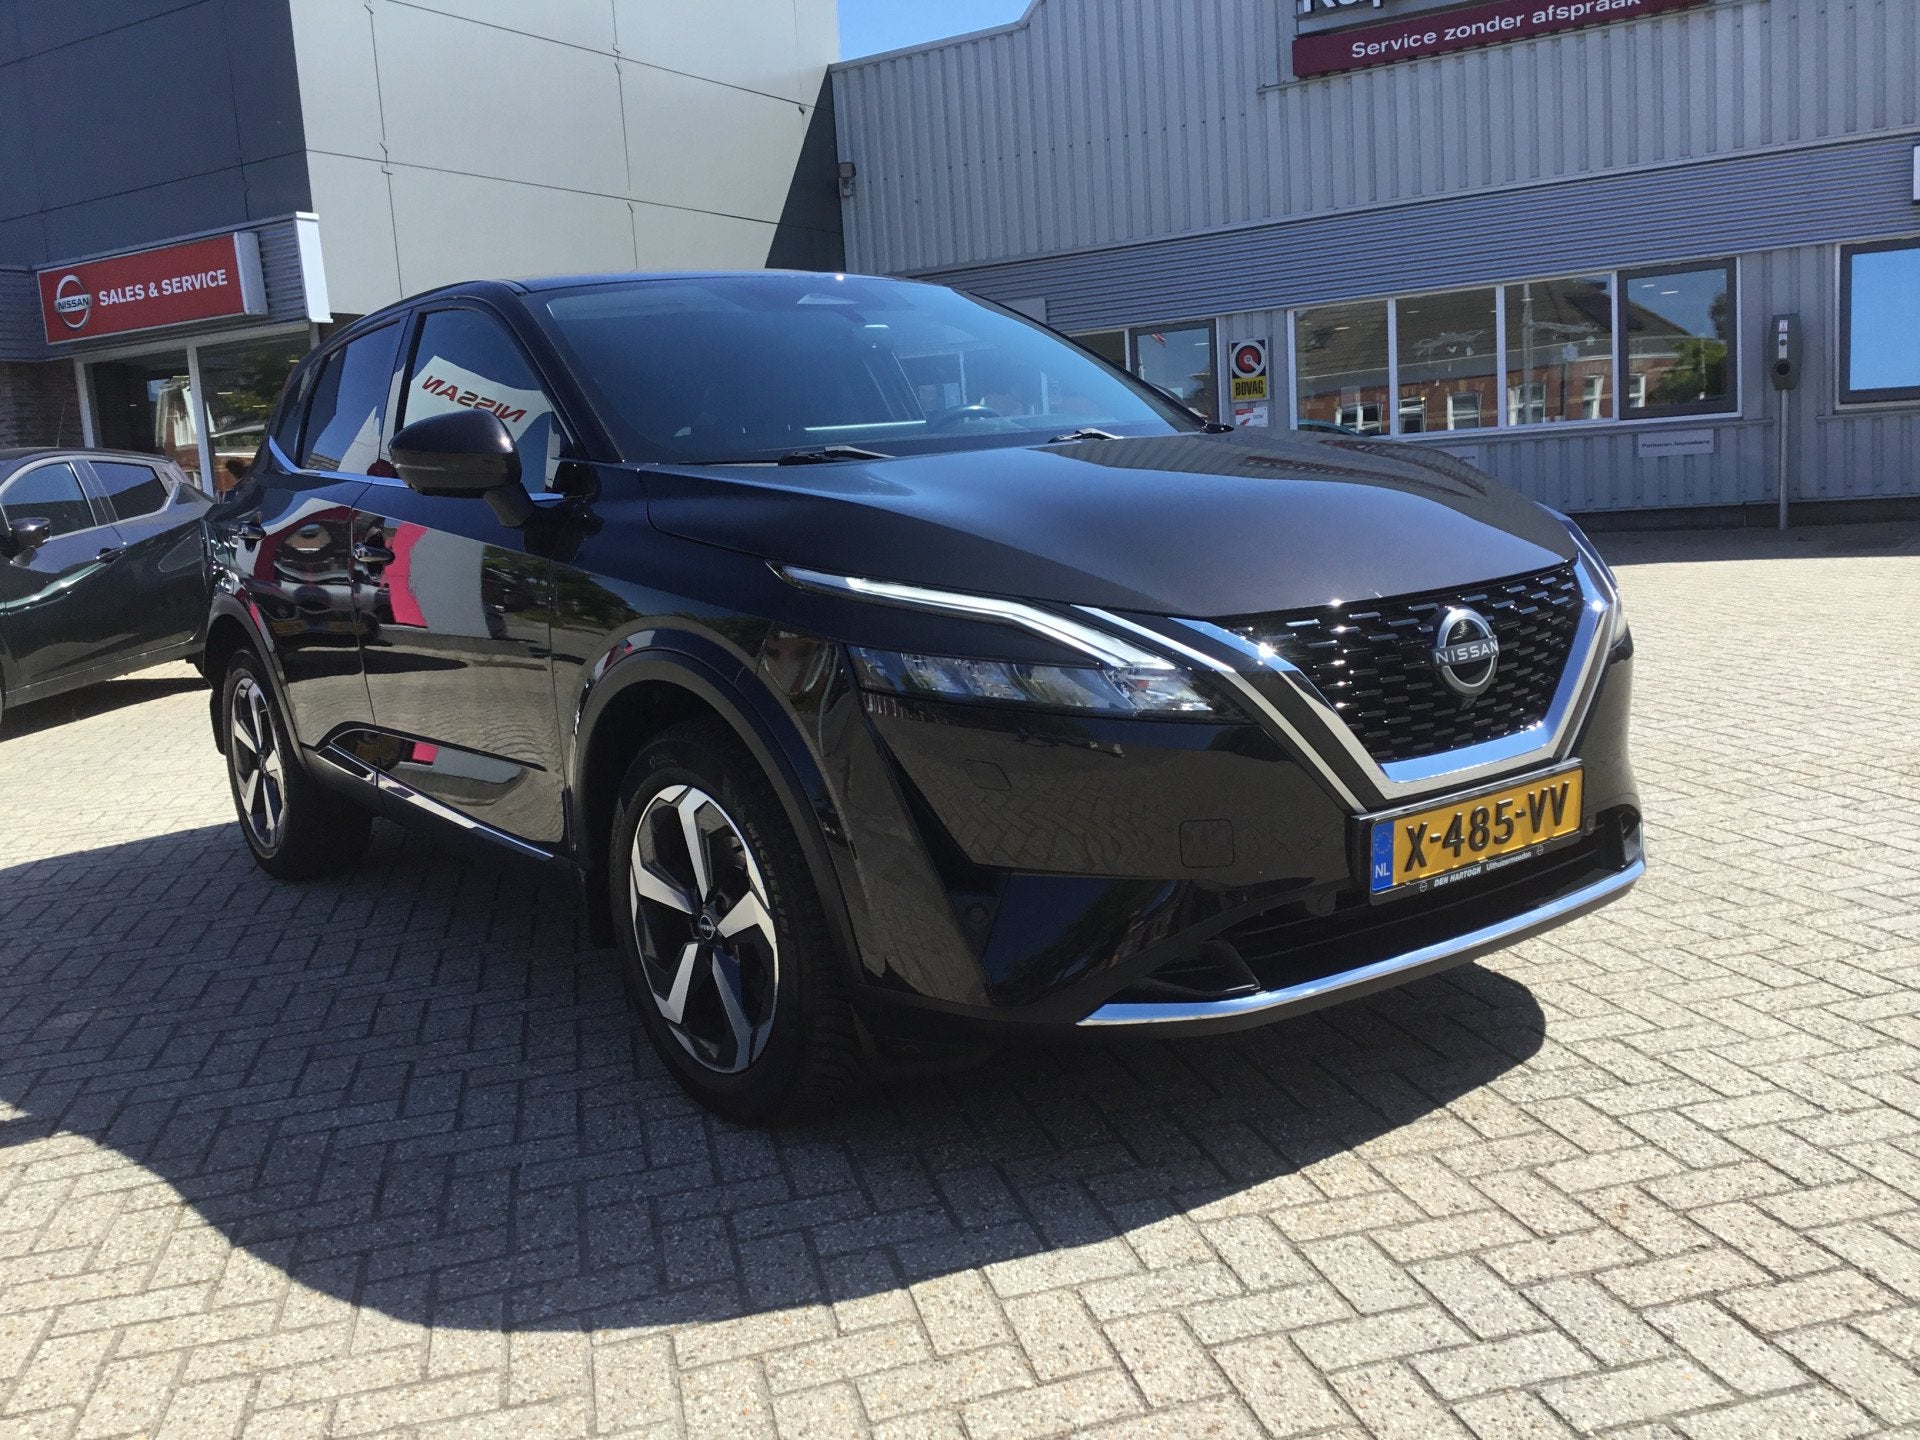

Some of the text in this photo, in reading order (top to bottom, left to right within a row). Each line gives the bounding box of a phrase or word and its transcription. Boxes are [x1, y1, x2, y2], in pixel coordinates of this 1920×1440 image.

[1352, 31, 1437, 58] Service
[1444, 14, 1525, 41] zonder
[98, 269, 228, 307] SALES & SERVICE
[57, 297, 90, 311] NISSAN
[1235, 380, 1264, 397] BOVAG
[1435, 640, 1499, 664] NISSAN
[1404, 780, 1570, 873] X-485-VV
[1375, 863, 1390, 879] NL
[1433, 875, 1449, 888] DEN
[1449, 866, 1482, 883] HARTOGH
